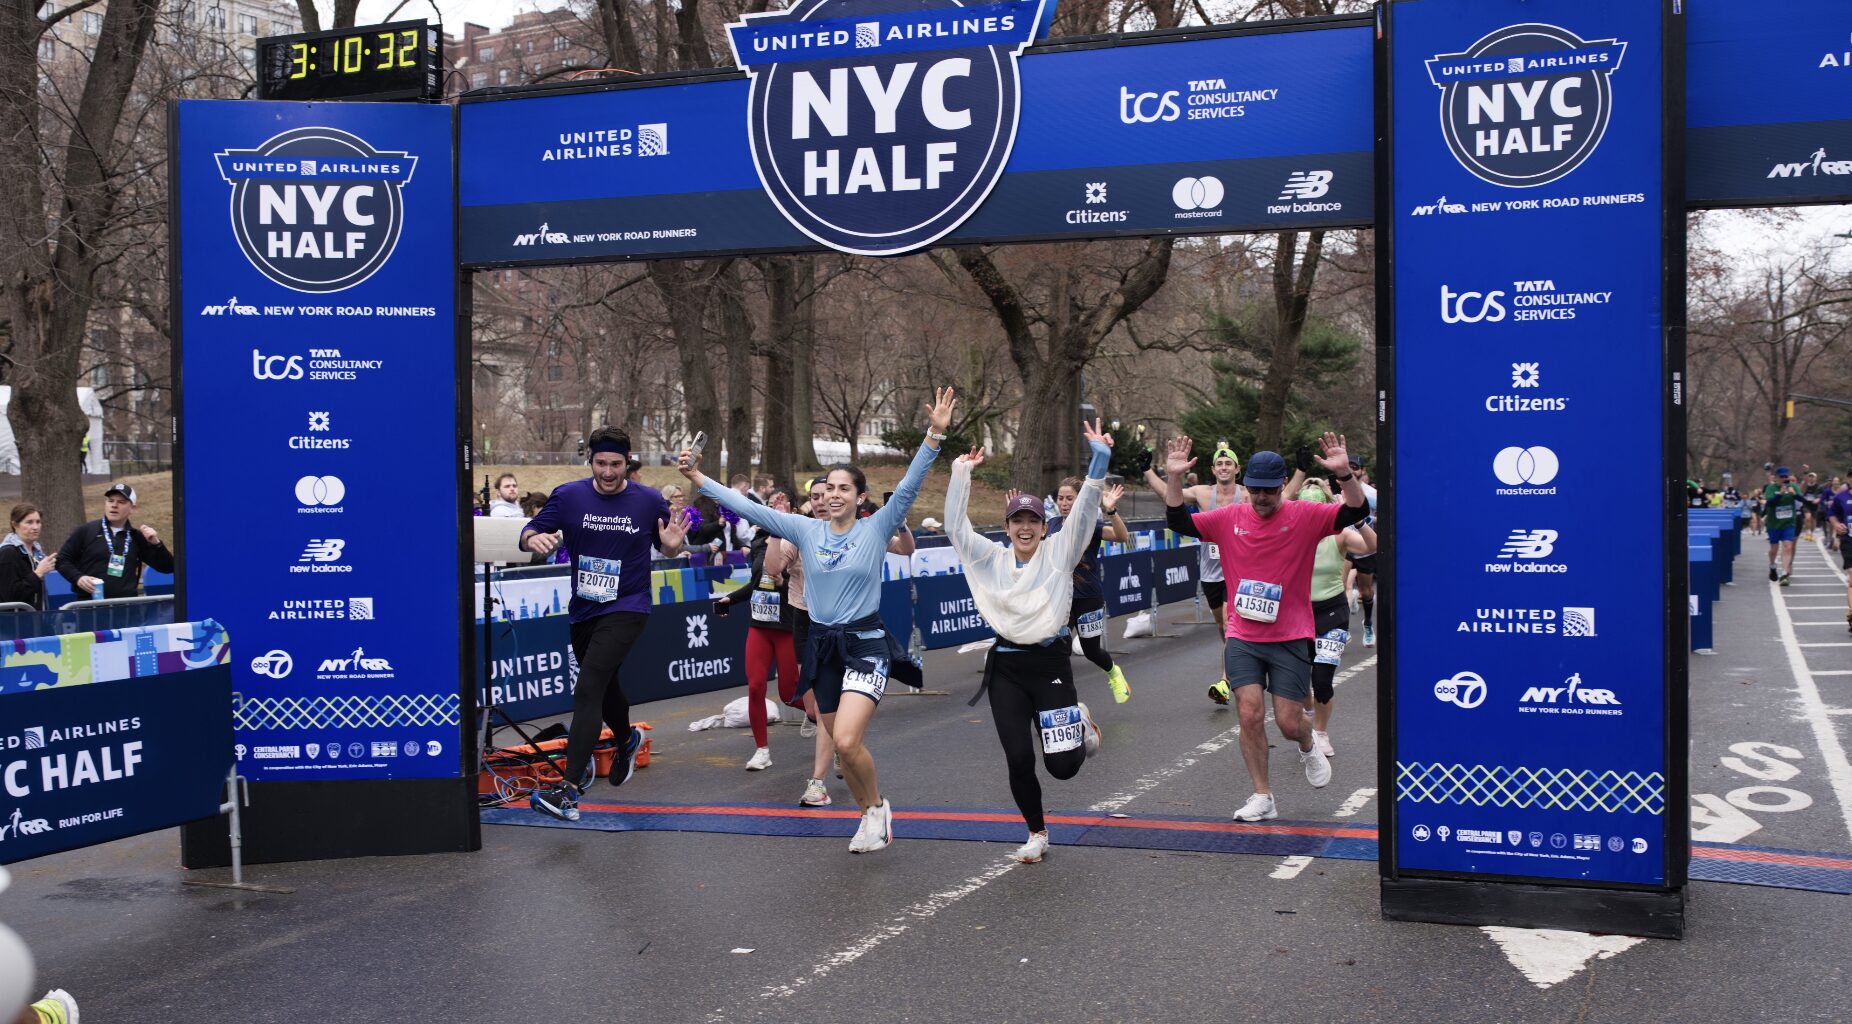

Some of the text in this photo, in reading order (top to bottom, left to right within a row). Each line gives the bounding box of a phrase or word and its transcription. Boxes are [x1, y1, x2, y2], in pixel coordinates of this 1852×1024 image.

[754, 16, 1014, 51] UNITED AIRLINES
[1443, 53, 1608, 75] UNITED AIRLINES
[792, 58, 971, 139] NYC
[1121, 79, 1226, 124] tcs TATA
[1187, 88, 1279, 106] CONSULTANCY
[1468, 77, 1582, 126] NYC
[1187, 105, 1246, 121] SERVICES
[560, 129, 631, 146] UNITED
[1474, 123, 1575, 158] HALF
[543, 143, 632, 161] AIRLINES
[233, 163, 399, 173] UNITED AIRLINES
[805, 142, 960, 198] HALF
[260, 185, 374, 226] NYC
[1268, 202, 1341, 213] new balance
[1472, 202, 1501, 212] NEW
[1505, 200, 1539, 210] YORK
[1543, 198, 1579, 208] ROAD
[1583, 193, 1644, 205] RUNNERS
[1066, 210, 1126, 223] Citizens
[1175, 209, 1222, 218] mastercard
[574, 234, 595, 242] NEW
[598, 233, 622, 241] YORK
[624, 232, 650, 240] ROAD
[653, 229, 696, 238] RUNNERS
[268, 232, 365, 258] HALF
[1441, 280, 1555, 323] tcs TATA
[1514, 291, 1611, 306] CONSULTANCY
[265, 307, 294, 315] NEW
[298, 307, 333, 315] YORK
[337, 307, 372, 315] ROAD
[377, 307, 435, 316] RUNNERS
[1514, 308, 1575, 321] SERVICES
[253, 349, 341, 379] tcs TATA
[309, 360, 382, 368] CONSULTANCY
[310, 371, 356, 379] SERVICES
[1486, 395, 1565, 411] Citizens
[289, 436, 349, 449] Citizens
[1497, 487, 1556, 495] mastercard
[583, 513, 632, 524] Alexandra's
[582, 522, 626, 532] Playground
[312, 564, 352, 572] balance
[1486, 562, 1567, 572] new balance
[580, 572, 616, 588] E 20770
[1166, 566, 1190, 586] STRAVA
[284, 600, 344, 608] UNITED
[1236, 597, 1274, 614] A 15316
[269, 611, 344, 619] AIRLINES
[1477, 609, 1555, 619] UNITED
[931, 614, 982, 634] AIRLINES
[1081, 624, 1086, 632] F
[1457, 622, 1556, 633] AIRLINES
[1316, 640, 1322, 649] B
[667, 655, 731, 684] Citizens
[846, 670, 884, 690] C 14313
[476, 675, 564, 708] IRLINES
[1436, 686, 1456, 695] abc
[50, 717, 142, 743] AIRLINES
[1044, 724, 1081, 744] F 19678
[39, 740, 142, 791] HALF
[59, 817, 80, 828] RUN
[82, 813, 101, 823] FOR
[103, 808, 123, 819] LIFE
